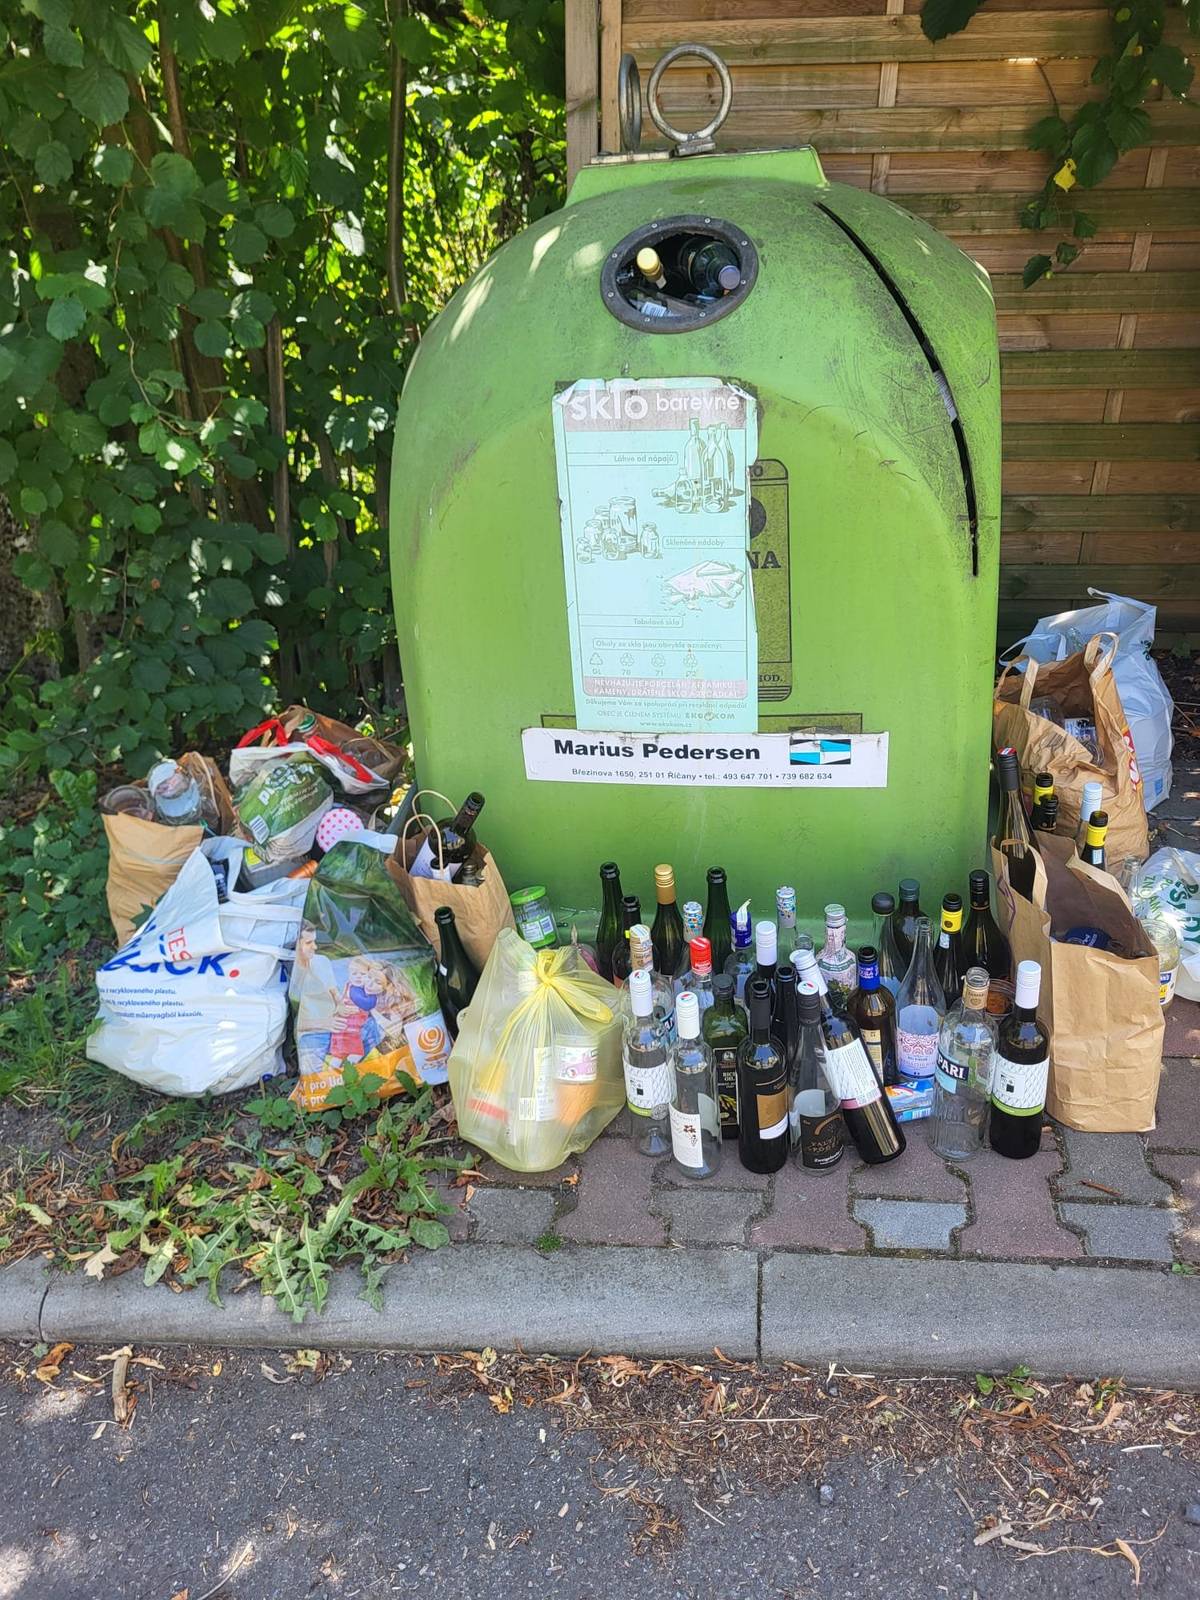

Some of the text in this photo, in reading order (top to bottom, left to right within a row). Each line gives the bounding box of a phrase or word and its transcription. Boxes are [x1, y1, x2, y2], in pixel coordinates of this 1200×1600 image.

[570, 385, 648, 420] sklo
[636, 454, 646, 463] od
[554, 739, 761, 761] Marius Pedersen
[572, 768, 613, 777] Březinova
[615, 770, 637, 780] 1650,
[638, 771, 653, 780] 251
[655, 771, 665, 780] 01
[667, 769, 697, 782] Říčany
[722, 772, 739, 781] 493
[740, 772, 757, 781] 647
[758, 772, 773, 781] 701
[781, 772, 797, 781] 739
[798, 772, 815, 781] 682
[816, 772, 833, 781] 634
